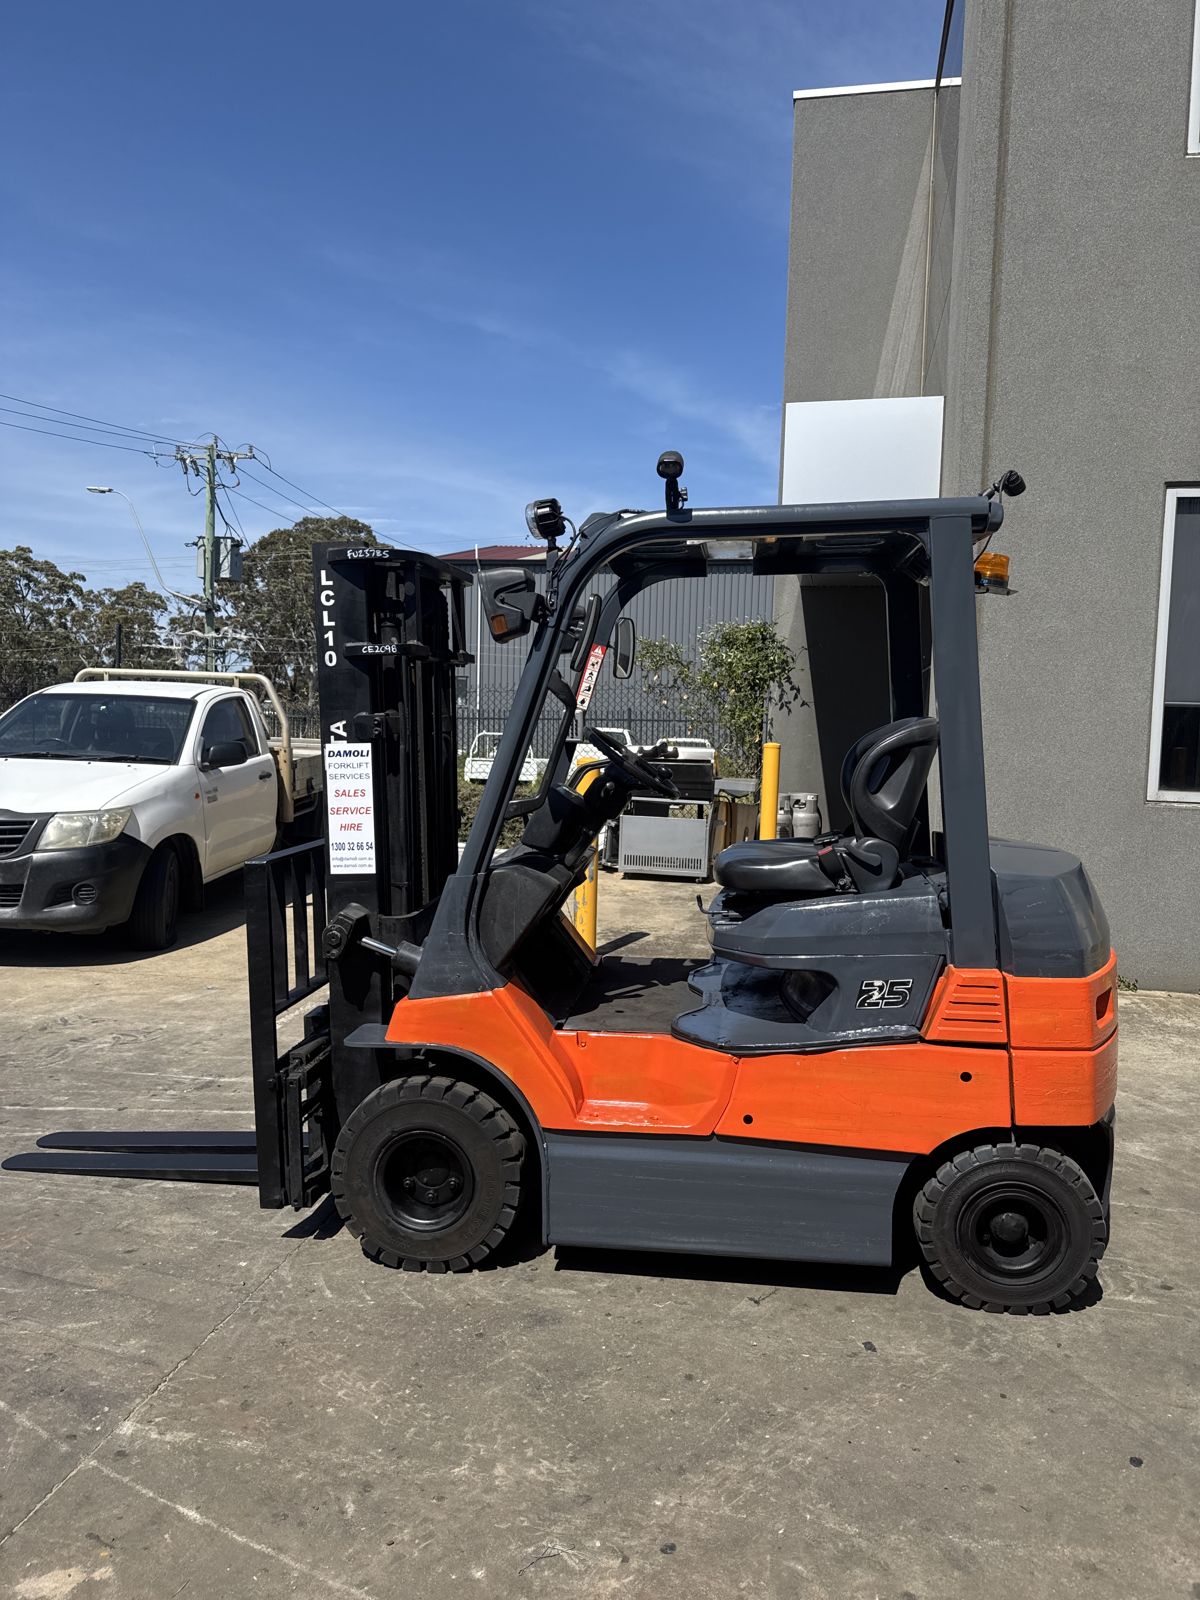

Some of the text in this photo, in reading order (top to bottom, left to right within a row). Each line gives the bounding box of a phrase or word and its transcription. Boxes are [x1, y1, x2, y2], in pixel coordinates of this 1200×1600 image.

[320, 569, 337, 667] LCL10
[361, 644, 398, 653] CE2098
[327, 749, 370, 758] DAMOLI
[334, 789, 366, 798] SALES
[330, 806, 372, 815] SERVICE
[339, 823, 364, 831] HIRE
[331, 841, 374, 851] 1300 32 66 54
[856, 979, 913, 1009] 25
